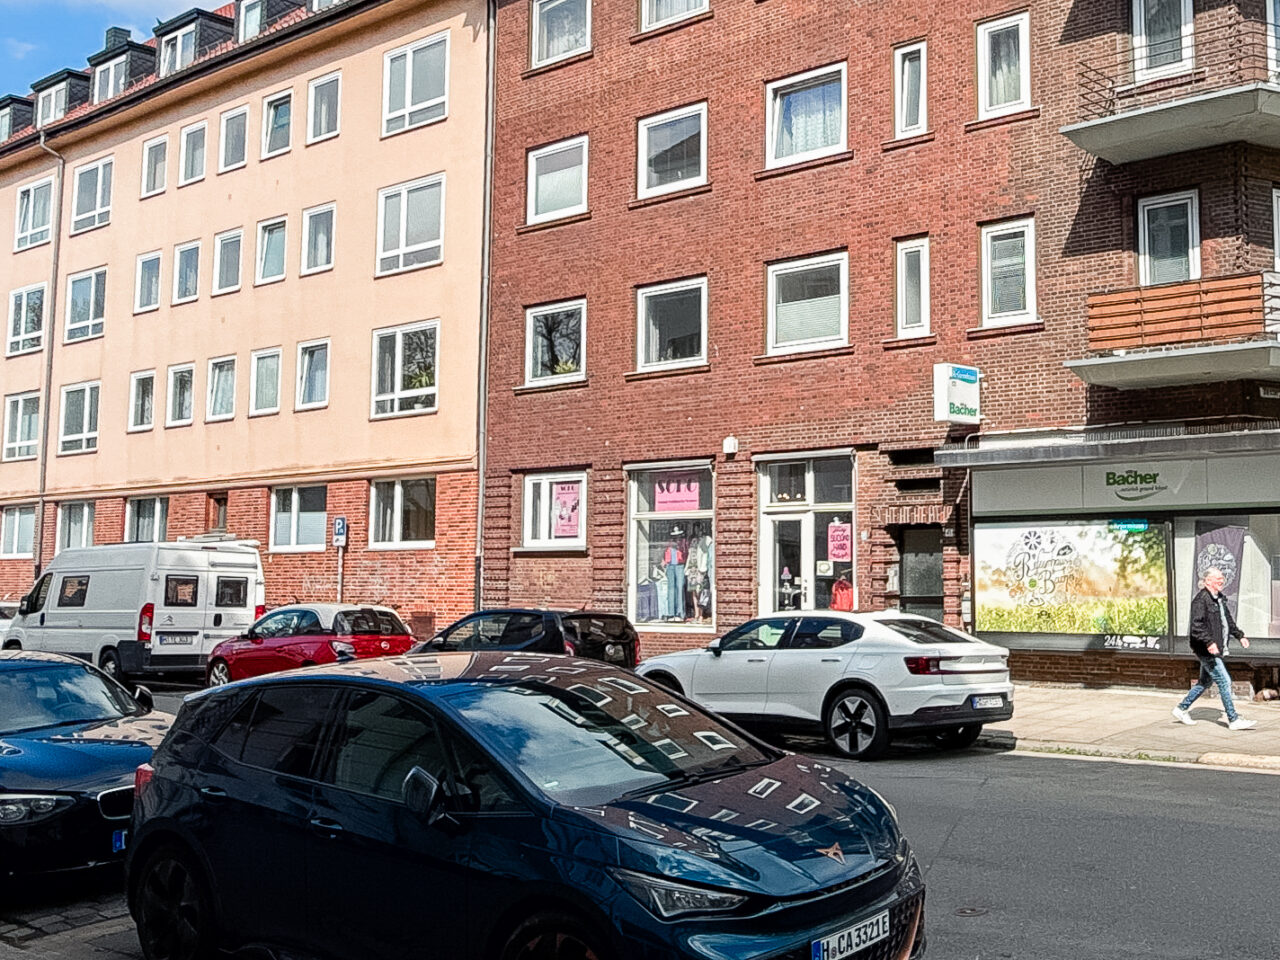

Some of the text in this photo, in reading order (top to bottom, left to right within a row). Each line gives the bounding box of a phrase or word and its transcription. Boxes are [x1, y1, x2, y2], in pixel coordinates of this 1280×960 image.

[949, 402, 978, 416] Bacher
[1106, 470, 1159, 486] Bacher
[822, 940, 830, 960] H
